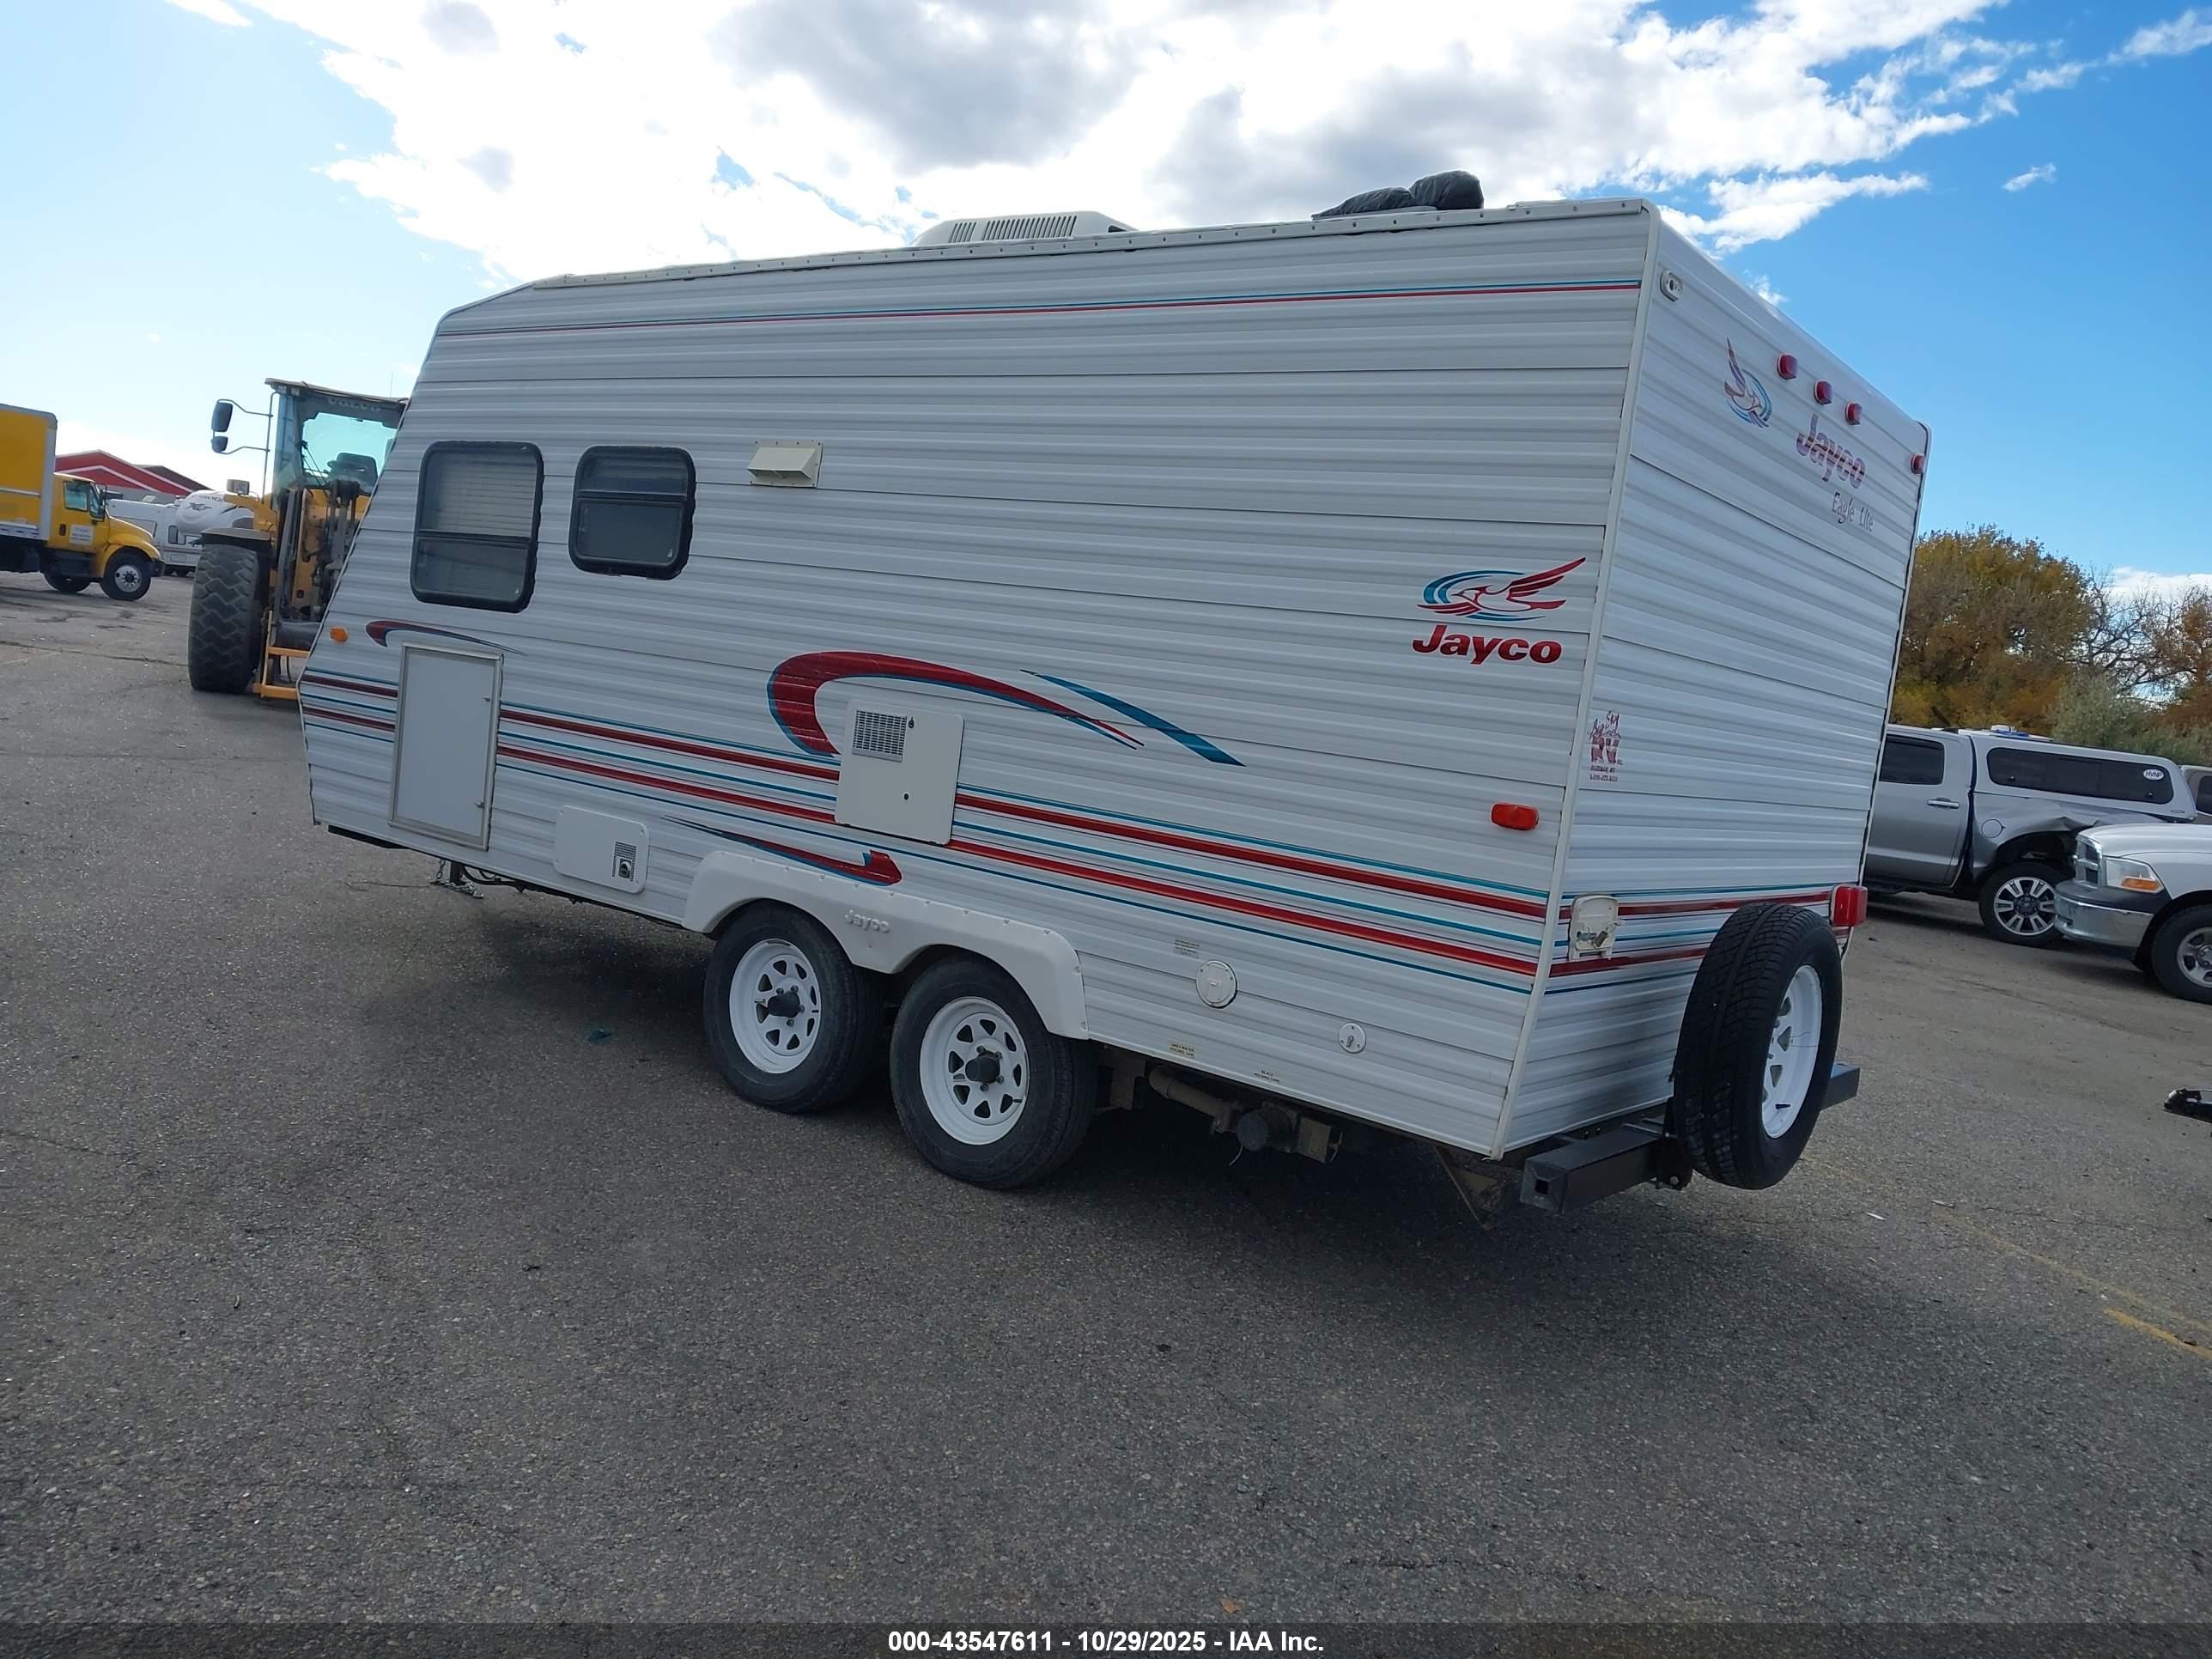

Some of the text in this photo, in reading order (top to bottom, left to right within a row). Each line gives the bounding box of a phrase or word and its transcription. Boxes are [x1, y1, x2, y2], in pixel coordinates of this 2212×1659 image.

[1796, 412, 1866, 489] Jayco
[1831, 490, 1856, 524] Eagle
[1412, 624, 1562, 665] Jayco
[844, 909, 890, 933] Jayco
